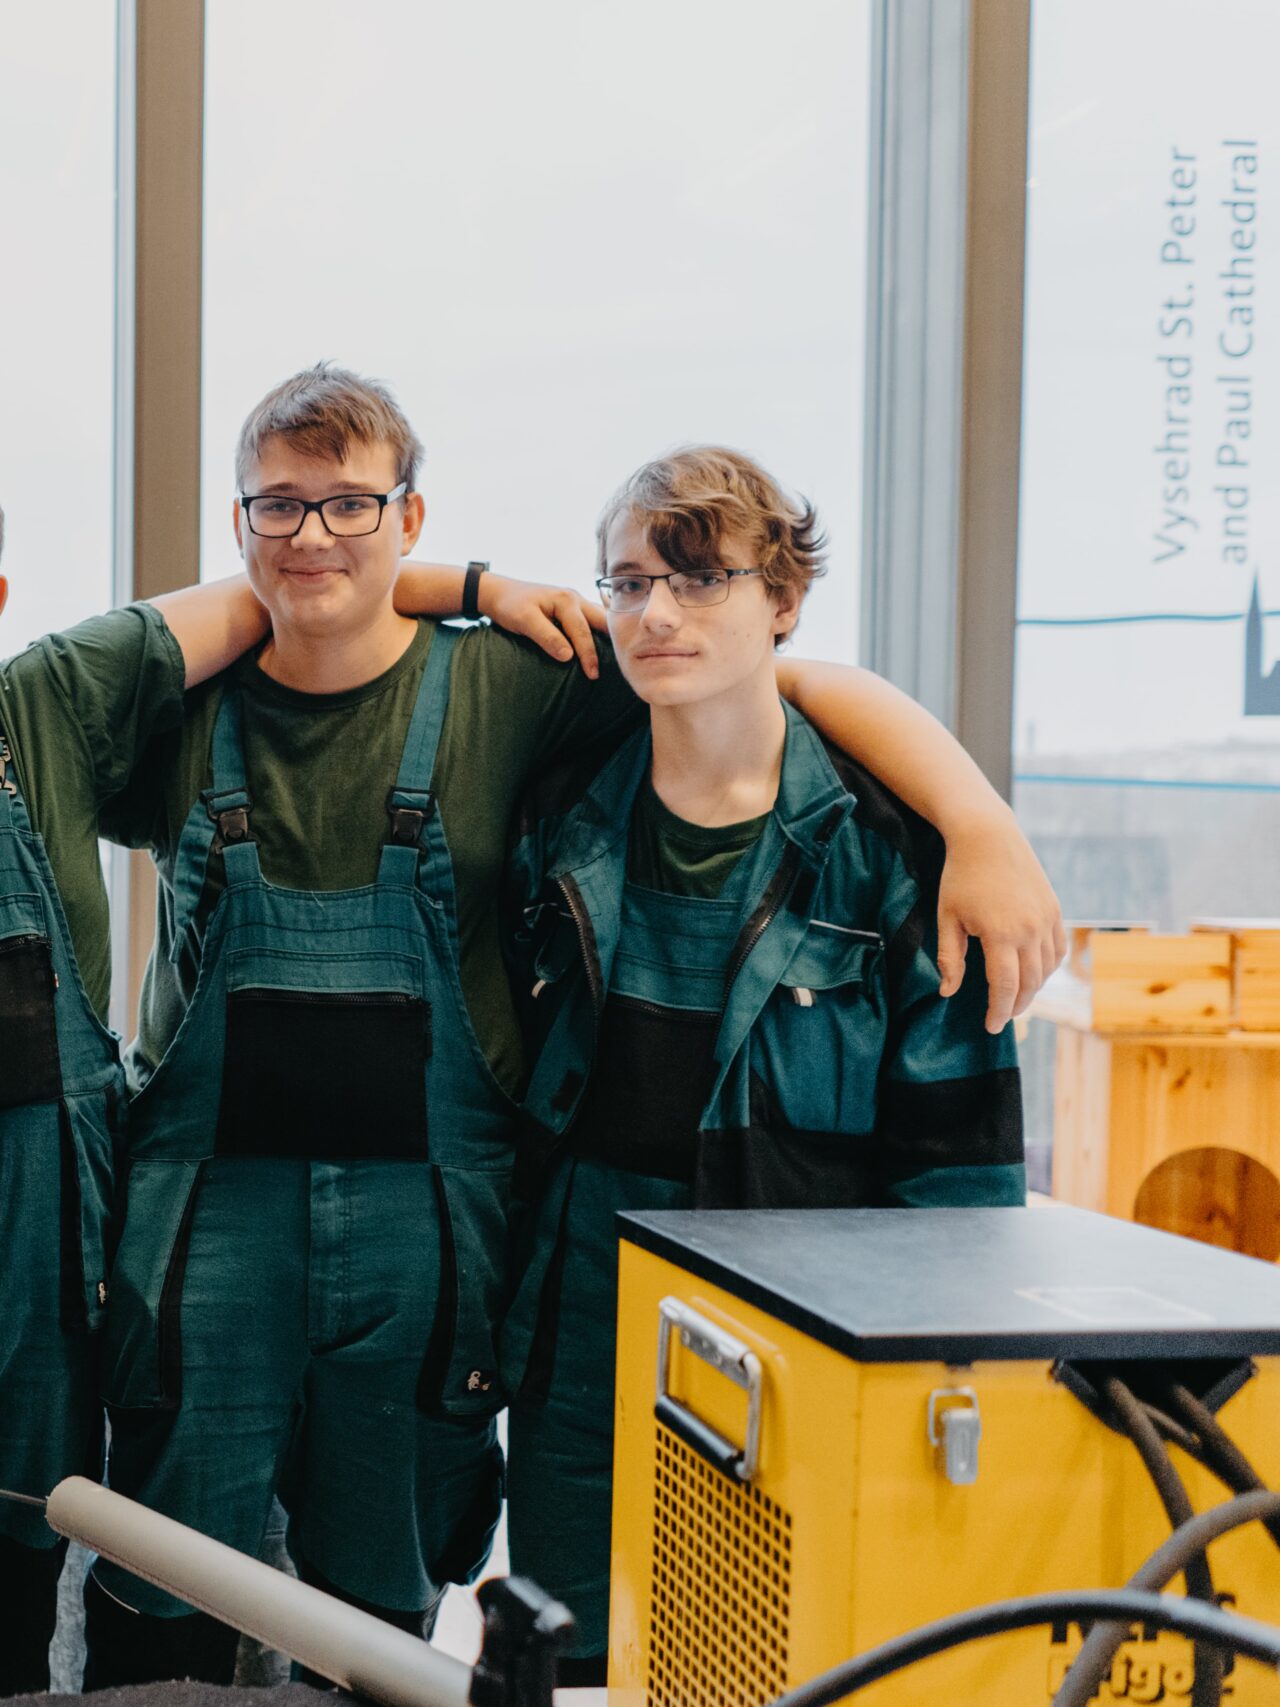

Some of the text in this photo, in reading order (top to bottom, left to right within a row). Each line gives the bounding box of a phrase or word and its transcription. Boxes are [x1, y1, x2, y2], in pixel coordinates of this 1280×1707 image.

[1153, 144, 1200, 564] Vysehrad St. Peter
[1214, 139, 1259, 565] and Paul Cathedral
